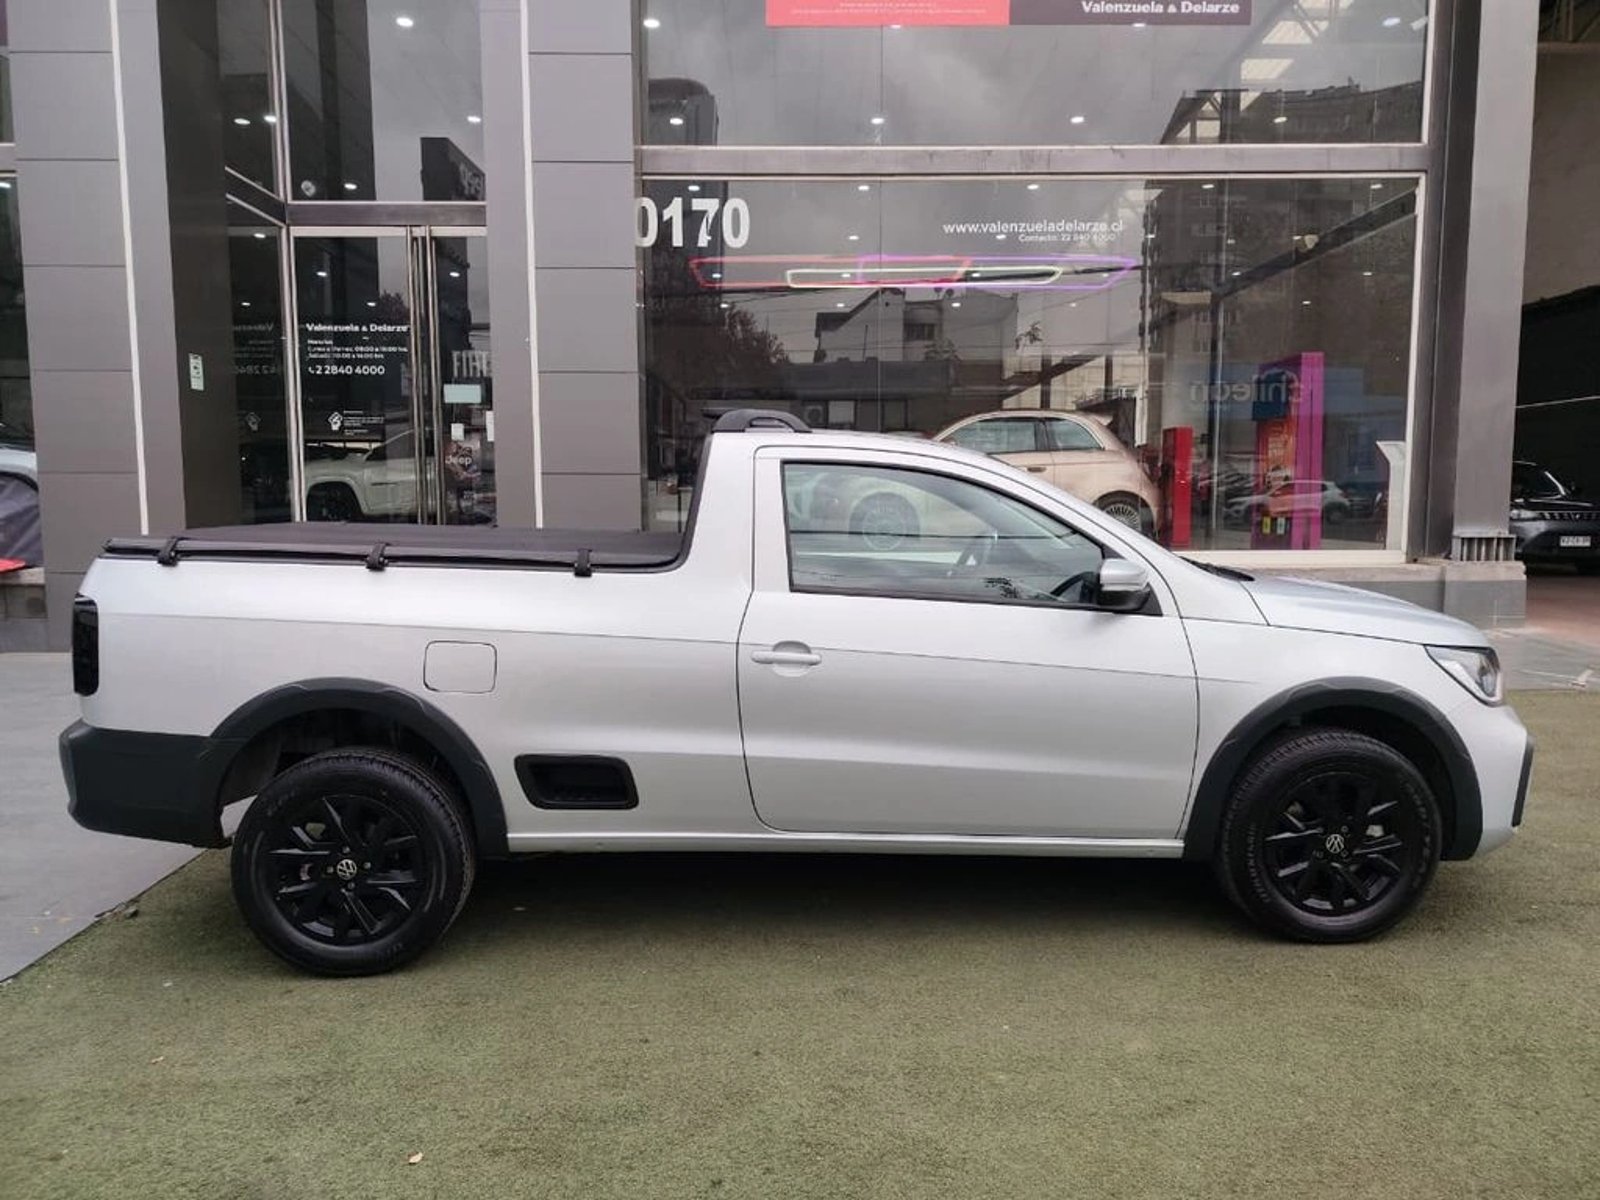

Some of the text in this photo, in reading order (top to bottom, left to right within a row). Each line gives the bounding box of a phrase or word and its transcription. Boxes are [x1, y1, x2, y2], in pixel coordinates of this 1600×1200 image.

[1081, 0, 1240, 14] Valenzuela & Delarze
[634, 196, 751, 249] 0170
[942, 219, 1123, 235] www.valenzueladelarze.cl
[305, 323, 360, 332] Valenzuela
[369, 323, 409, 332] Delarze
[315, 365, 386, 375] 2 2840 4000
[451, 349, 489, 378] FIAT
[444, 454, 473, 468] Jeep
